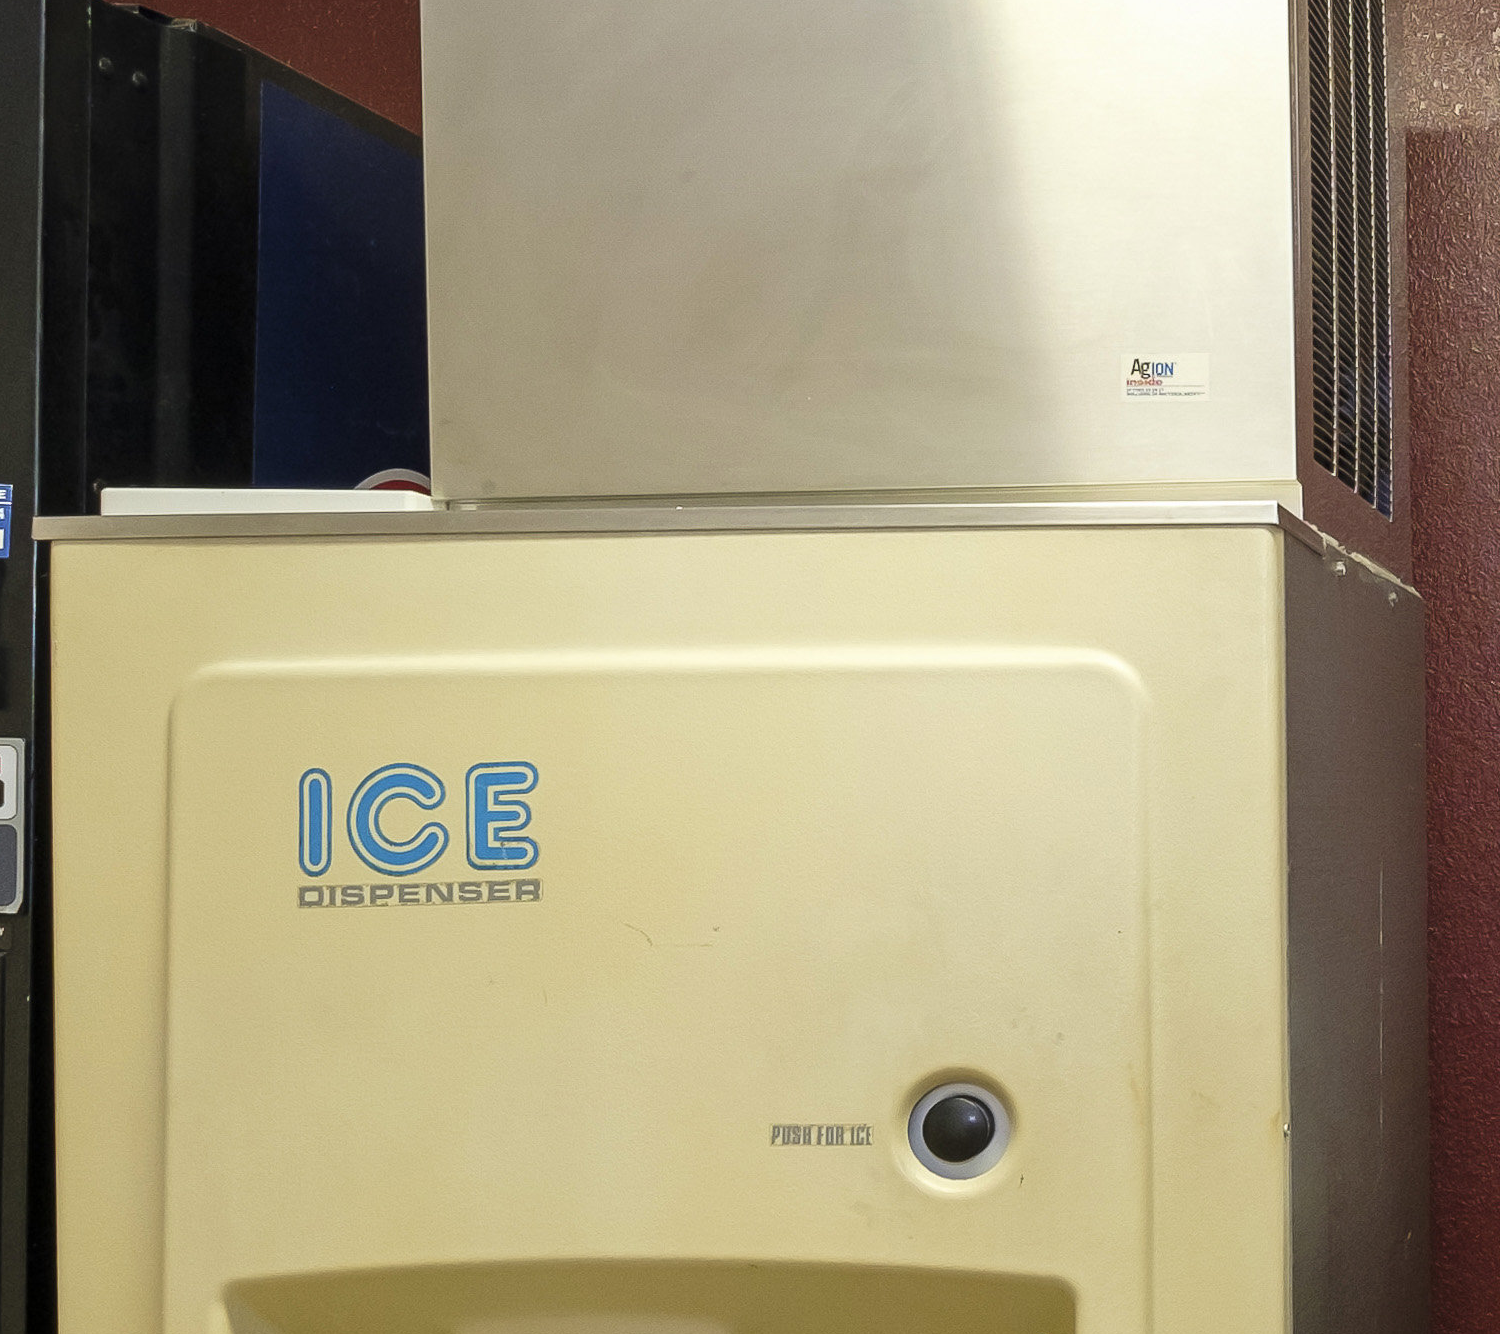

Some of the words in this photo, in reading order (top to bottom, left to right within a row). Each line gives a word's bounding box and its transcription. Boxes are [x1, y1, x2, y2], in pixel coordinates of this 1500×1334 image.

[299, 761, 539, 877] ICE
[299, 879, 541, 907] DISPENSER
[771, 1125, 812, 1145] PUSH
[817, 1125, 844, 1145] FOR
[850, 1125, 873, 1145] ICE
